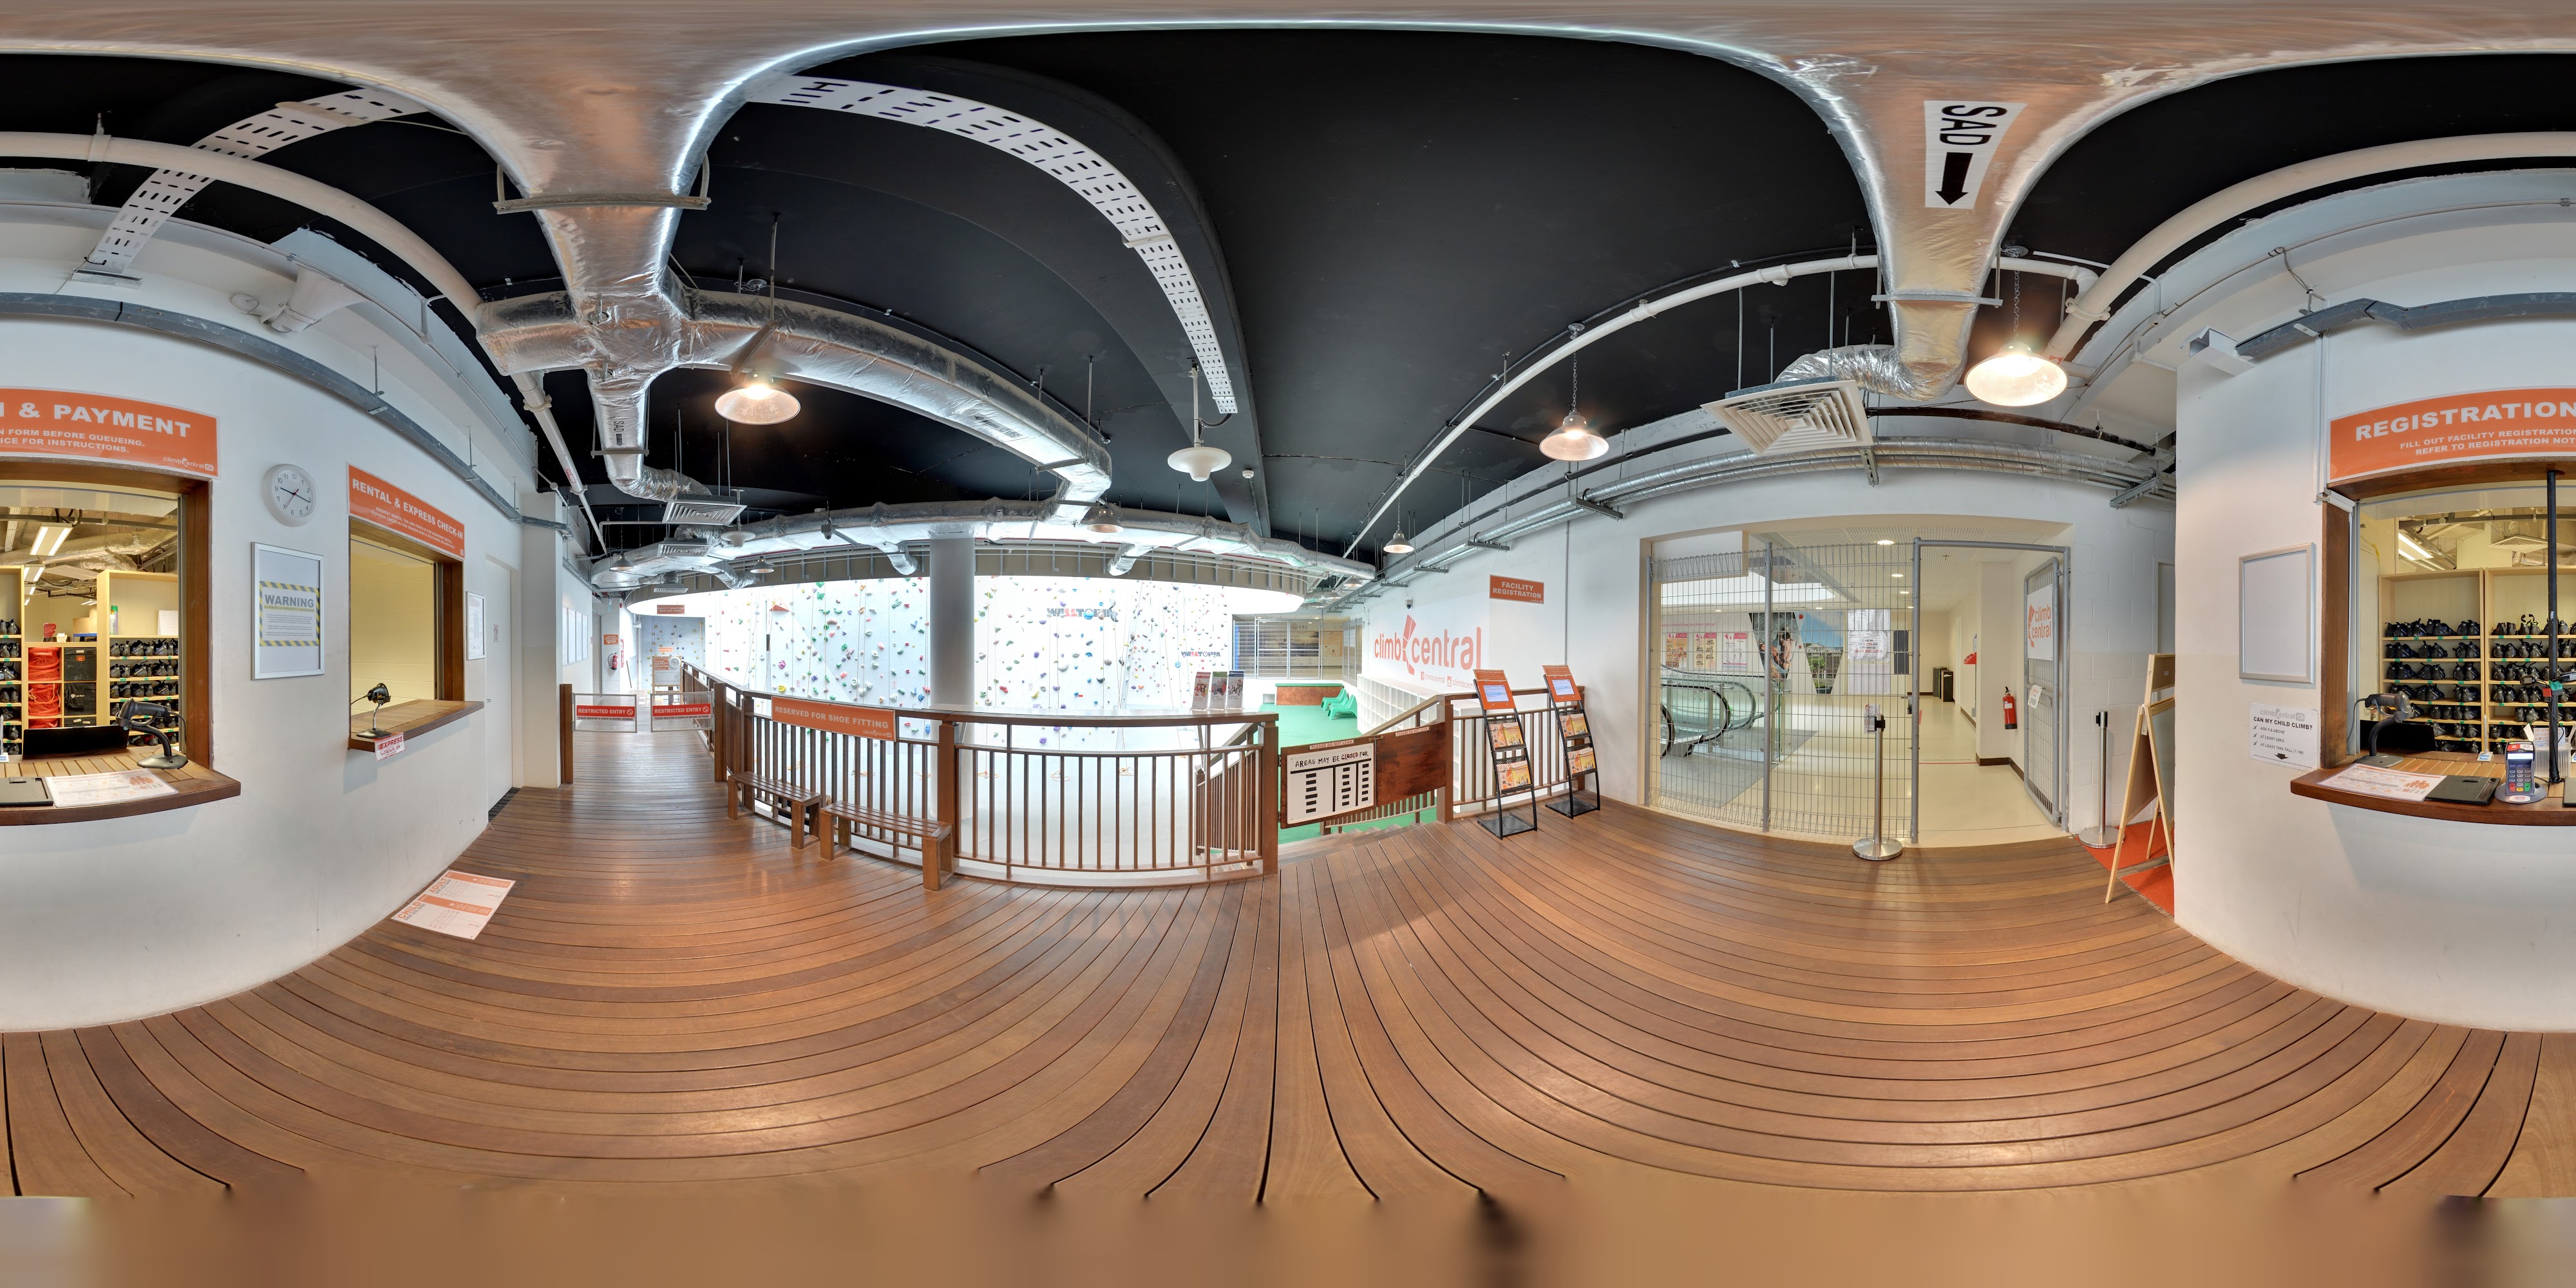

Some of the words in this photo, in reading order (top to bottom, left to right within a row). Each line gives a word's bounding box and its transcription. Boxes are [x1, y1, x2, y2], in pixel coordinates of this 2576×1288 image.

[1940, 105, 2007, 146] SAD
[19, 402, 41, 418] &
[54, 404, 191, 438] PAYMENT
[614, 421, 625, 432] SAD
[2356, 402, 2576, 441] REGISTRATION
[43, 431, 86, 439] BEFORE
[89, 434, 145, 447] QUEUEING.
[48, 439, 129, 453] INSTRUCTIONS.
[2400, 440, 2421, 450] FILL
[2423, 437, 2445, 446] OUT
[2448, 432, 2496, 442] FACILITY
[2416, 446, 2448, 455] REFER
[2468, 438, 2550, 449] REGISTRATION
[353, 478, 392, 505] RENTAL
[395, 498, 401, 509] &
[403, 502, 436, 526] EXPRESS
[437, 519, 463, 540] CHECK-IN
[371, 511, 386, 520] EXPRESS
[376, 507, 391, 516] PRESENT
[1493, 588, 1541, 598] REGISTRATION
[1502, 582, 1534, 591] FACILITY
[265, 594, 314, 608] WARNING
[2035, 604, 2051, 623] climb
[2032, 621, 2051, 639] central
[1374, 632, 1401, 661] climb
[1412, 627, 1481, 670] central
[1453, 679, 1476, 690] climbcent
[775, 706, 809, 717] RESERVED
[829, 715, 850, 724] SHOE
[853, 718, 889, 729] FITTING
[379, 737, 402, 750] EXPRESS
[381, 746, 395, 755] CHECK
[1296, 759, 1316, 768] AREAS
[429, 877, 448, 894] ADULT
[397, 902, 422, 919] CHILD
